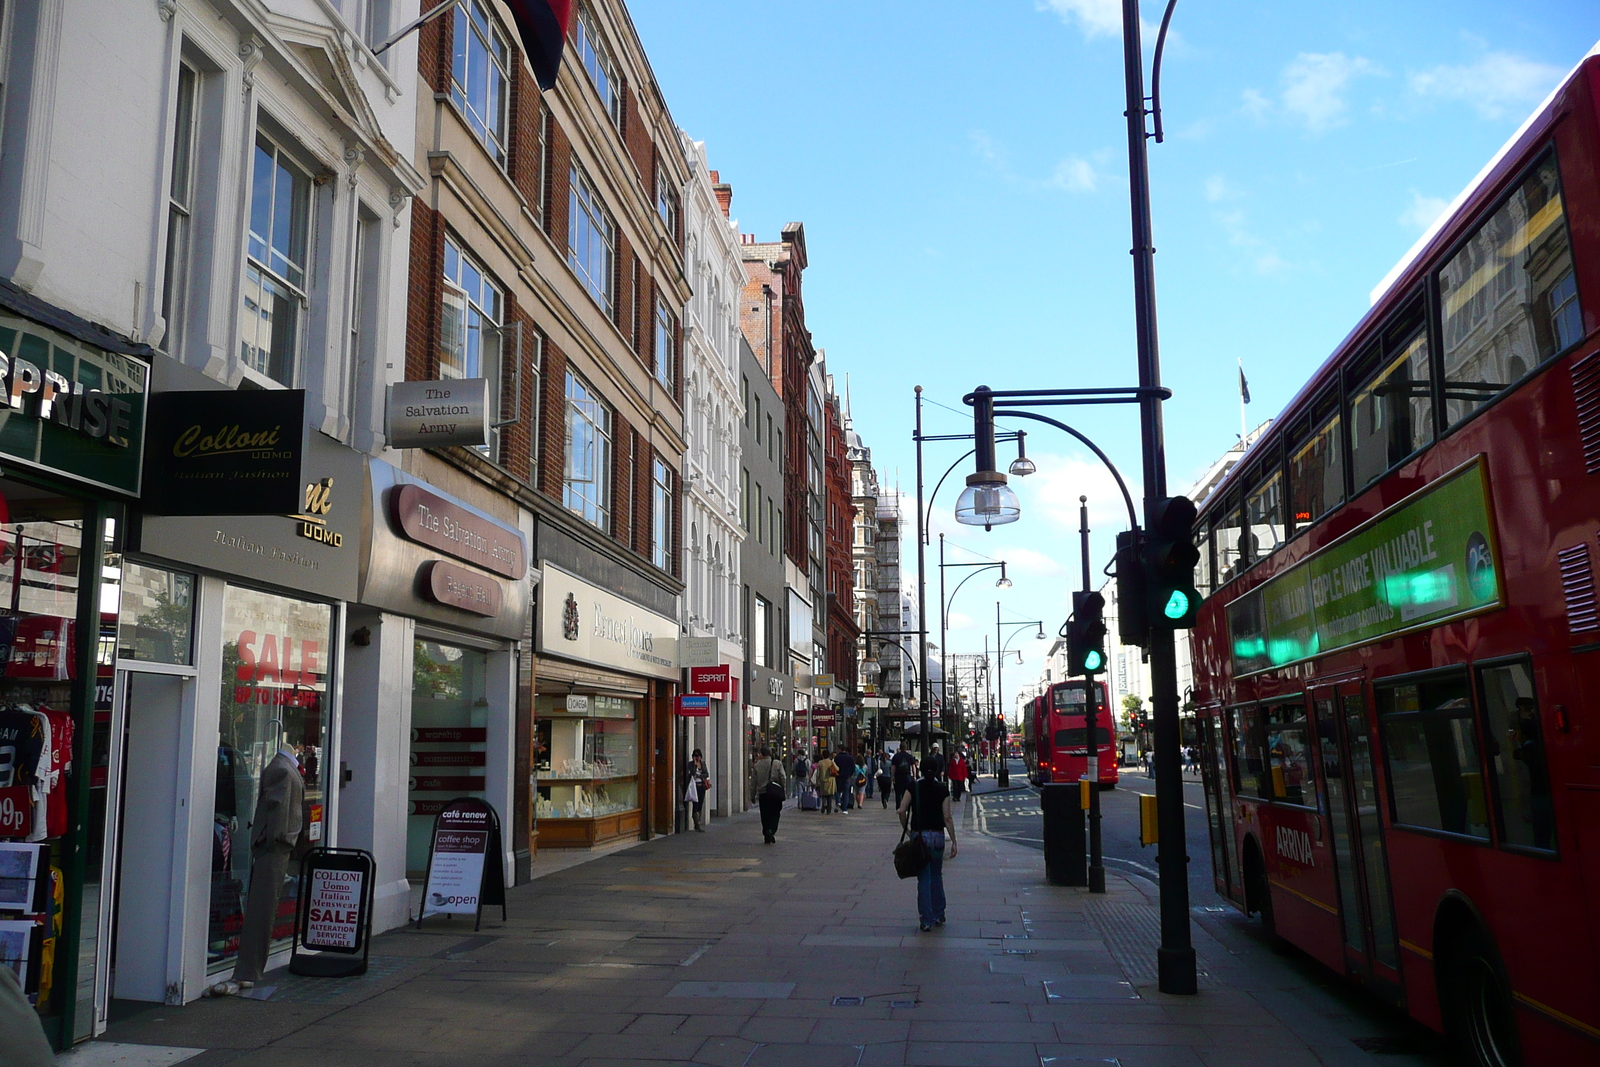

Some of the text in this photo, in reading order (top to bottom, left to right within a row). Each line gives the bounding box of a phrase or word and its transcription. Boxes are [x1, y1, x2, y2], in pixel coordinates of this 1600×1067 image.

[426, 388, 451, 399] The
[405, 404, 469, 417] Salvation
[418, 422, 457, 435] Army
[172, 424, 281, 458] Colloni
[252, 451, 292, 459] UOMO
[303, 521, 343, 547] UOMO
[418, 504, 516, 569] The Salvation Army
[213, 530, 319, 570] Italian Fashion
[1340, 553, 1372, 597] MORE
[1370, 520, 1437, 583] VALUABLE
[447, 575, 492, 605] Regent Hall
[594, 601, 628, 645] Ernest
[237, 630, 318, 686] SALE
[698, 674, 727, 683] ESPRIT
[235, 686, 252, 704] UP
[255, 688, 270, 705] TO
[299, 692, 317, 708] OFF
[572, 698, 587, 710] OMEGA
[425, 731, 462, 740] worship
[423, 756, 475, 764] community
[442, 810, 487, 820] café renew
[438, 835, 480, 846] coffee shop
[1276, 825, 1315, 867] ARRIVA
[314, 870, 360, 882] COLLONI
[322, 881, 350, 890] Uomo
[320, 892, 350, 901] Italian
[447, 895, 477, 907] open
[312, 899, 358, 909] Menswear
[310, 908, 358, 924] SALE
[310, 924, 355, 933] ALTERATION
[316, 931, 347, 940] SERVICE
[311, 938, 351, 947] AVAILABLE
